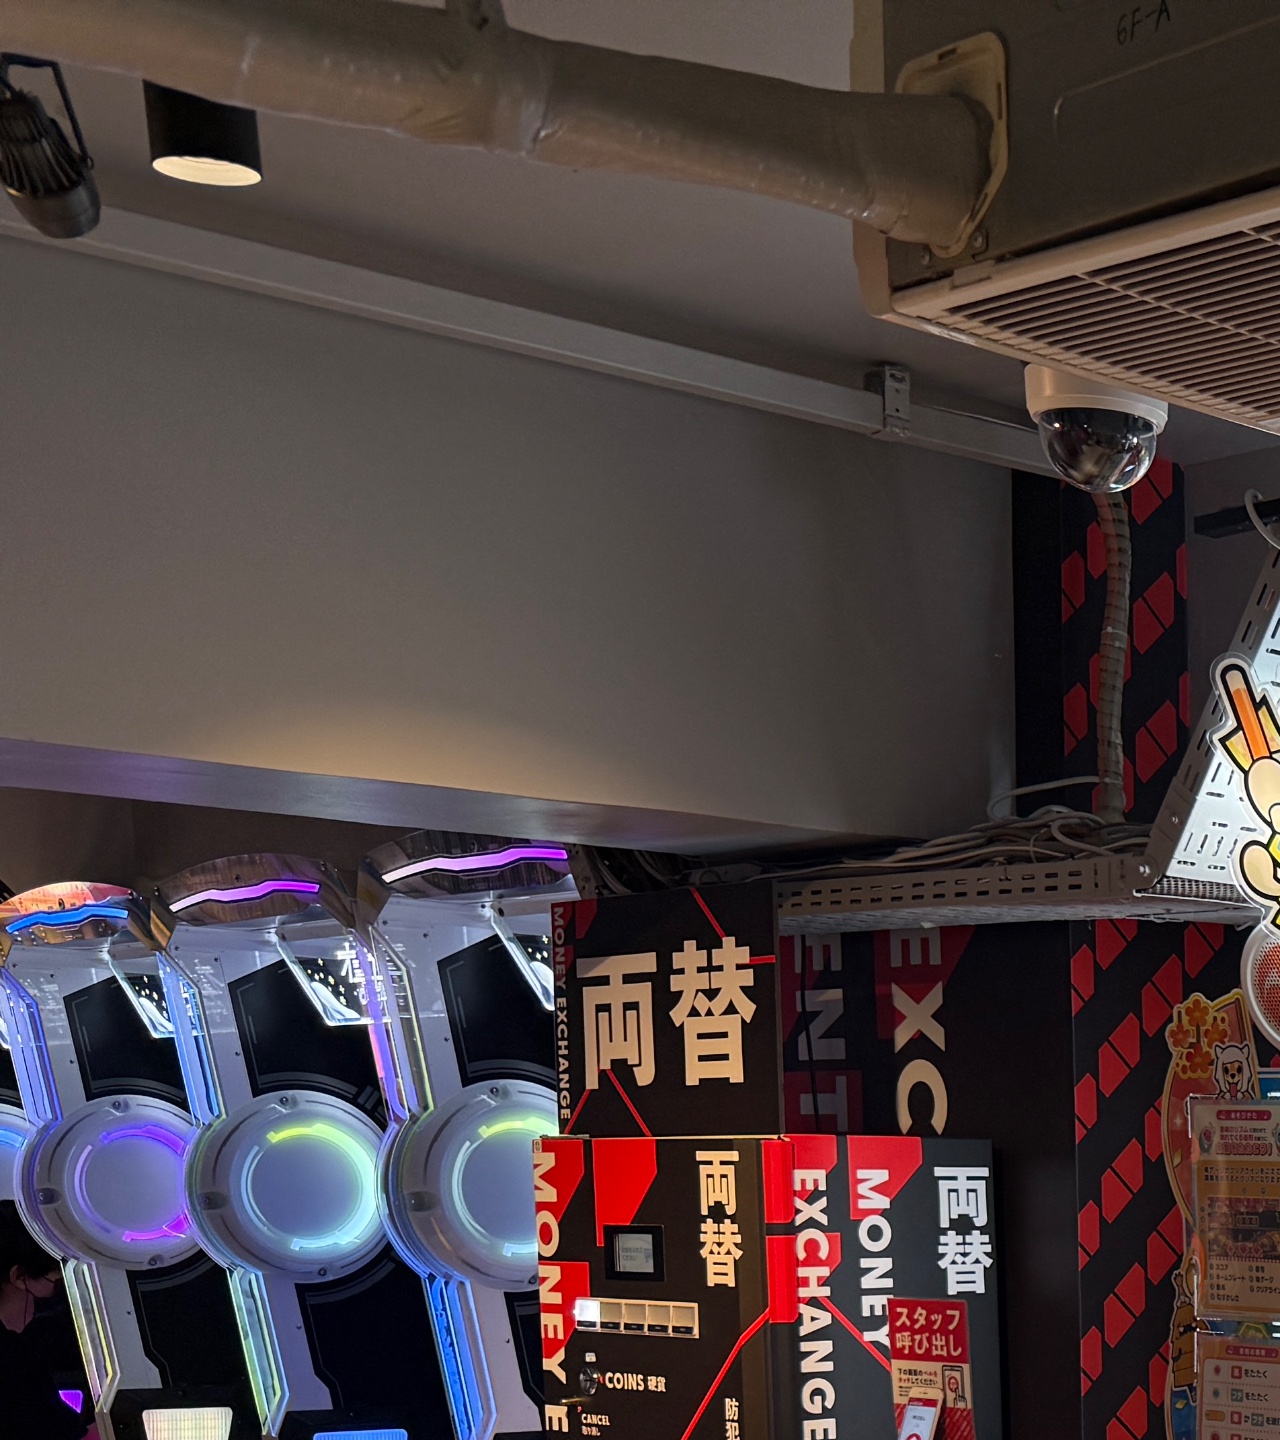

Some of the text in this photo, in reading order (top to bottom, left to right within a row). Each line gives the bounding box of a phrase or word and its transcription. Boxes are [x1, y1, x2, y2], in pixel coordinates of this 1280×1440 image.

[552, 907, 571, 1120] MONEY EXCHANGE
[575, 937, 757, 1089] 両替
[531, 1152, 566, 1384] MONEY
[696, 1150, 742, 1287] 両替
[857, 1169, 893, 1350] MONEY
[934, 1166, 993, 1294] 両替
[605, 1372, 645, 1391] COINS
[895, 1307, 960, 1330] スタッフ
[896, 1332, 962, 1357] 呼び出し
[581, 1413, 610, 1426] CANCEL
